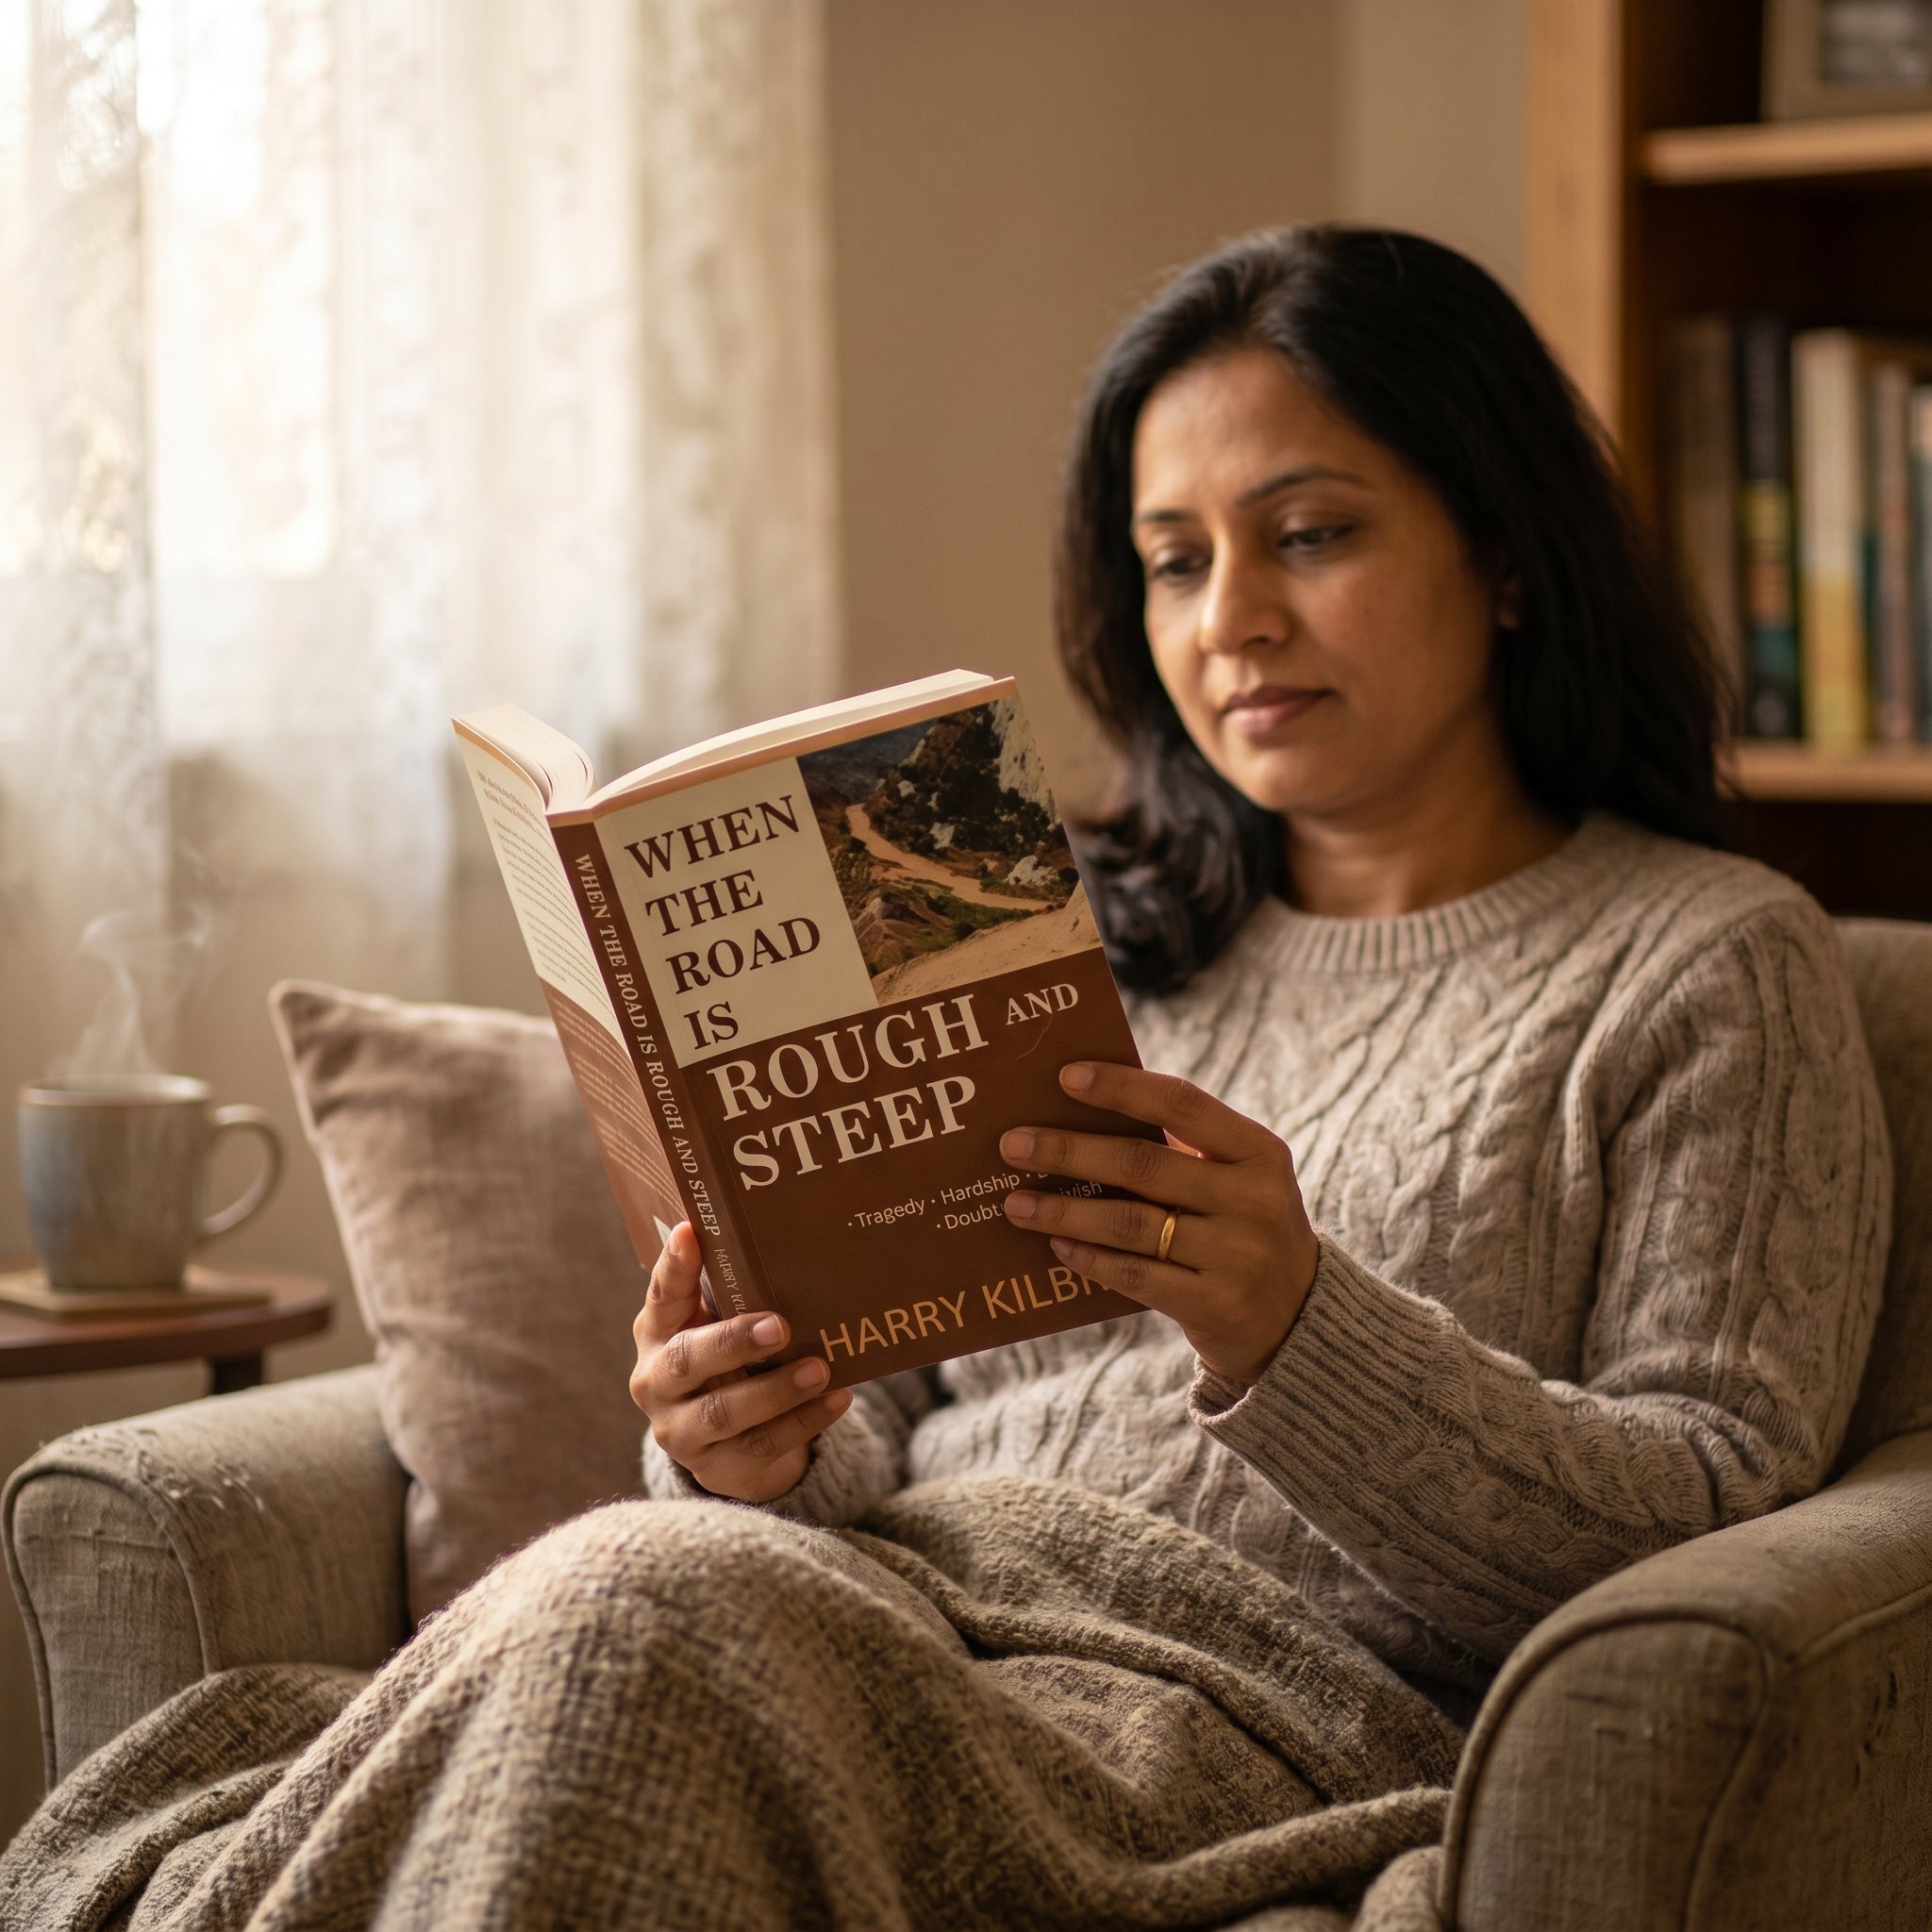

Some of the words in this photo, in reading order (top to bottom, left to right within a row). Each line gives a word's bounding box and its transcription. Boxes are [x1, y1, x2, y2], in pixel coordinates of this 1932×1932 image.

[624, 794, 800, 879] WHEN
[575, 853, 611, 919] WHEN
[644, 869, 764, 937] THE
[599, 924, 627, 967] THE
[665, 917, 821, 995] ROAD
[615, 973, 648, 1029] ROAD
[683, 1001, 740, 1050] IS
[637, 1034, 658, 1055] IS
[707, 993, 989, 1121] ROUGH
[1006, 982, 1079, 1025] AND
[645, 1060, 685, 1130] ROUGH
[673, 1136, 699, 1174] AND
[733, 1075, 976, 1191] STEEP
[689, 1179, 721, 1237] STEEP
[855, 1197, 924, 1227] Tragedy
[941, 1173, 1021, 1205] Hardship
[944, 1204, 1003, 1230] Doubt
[819, 1291, 967, 1362] HARRY
